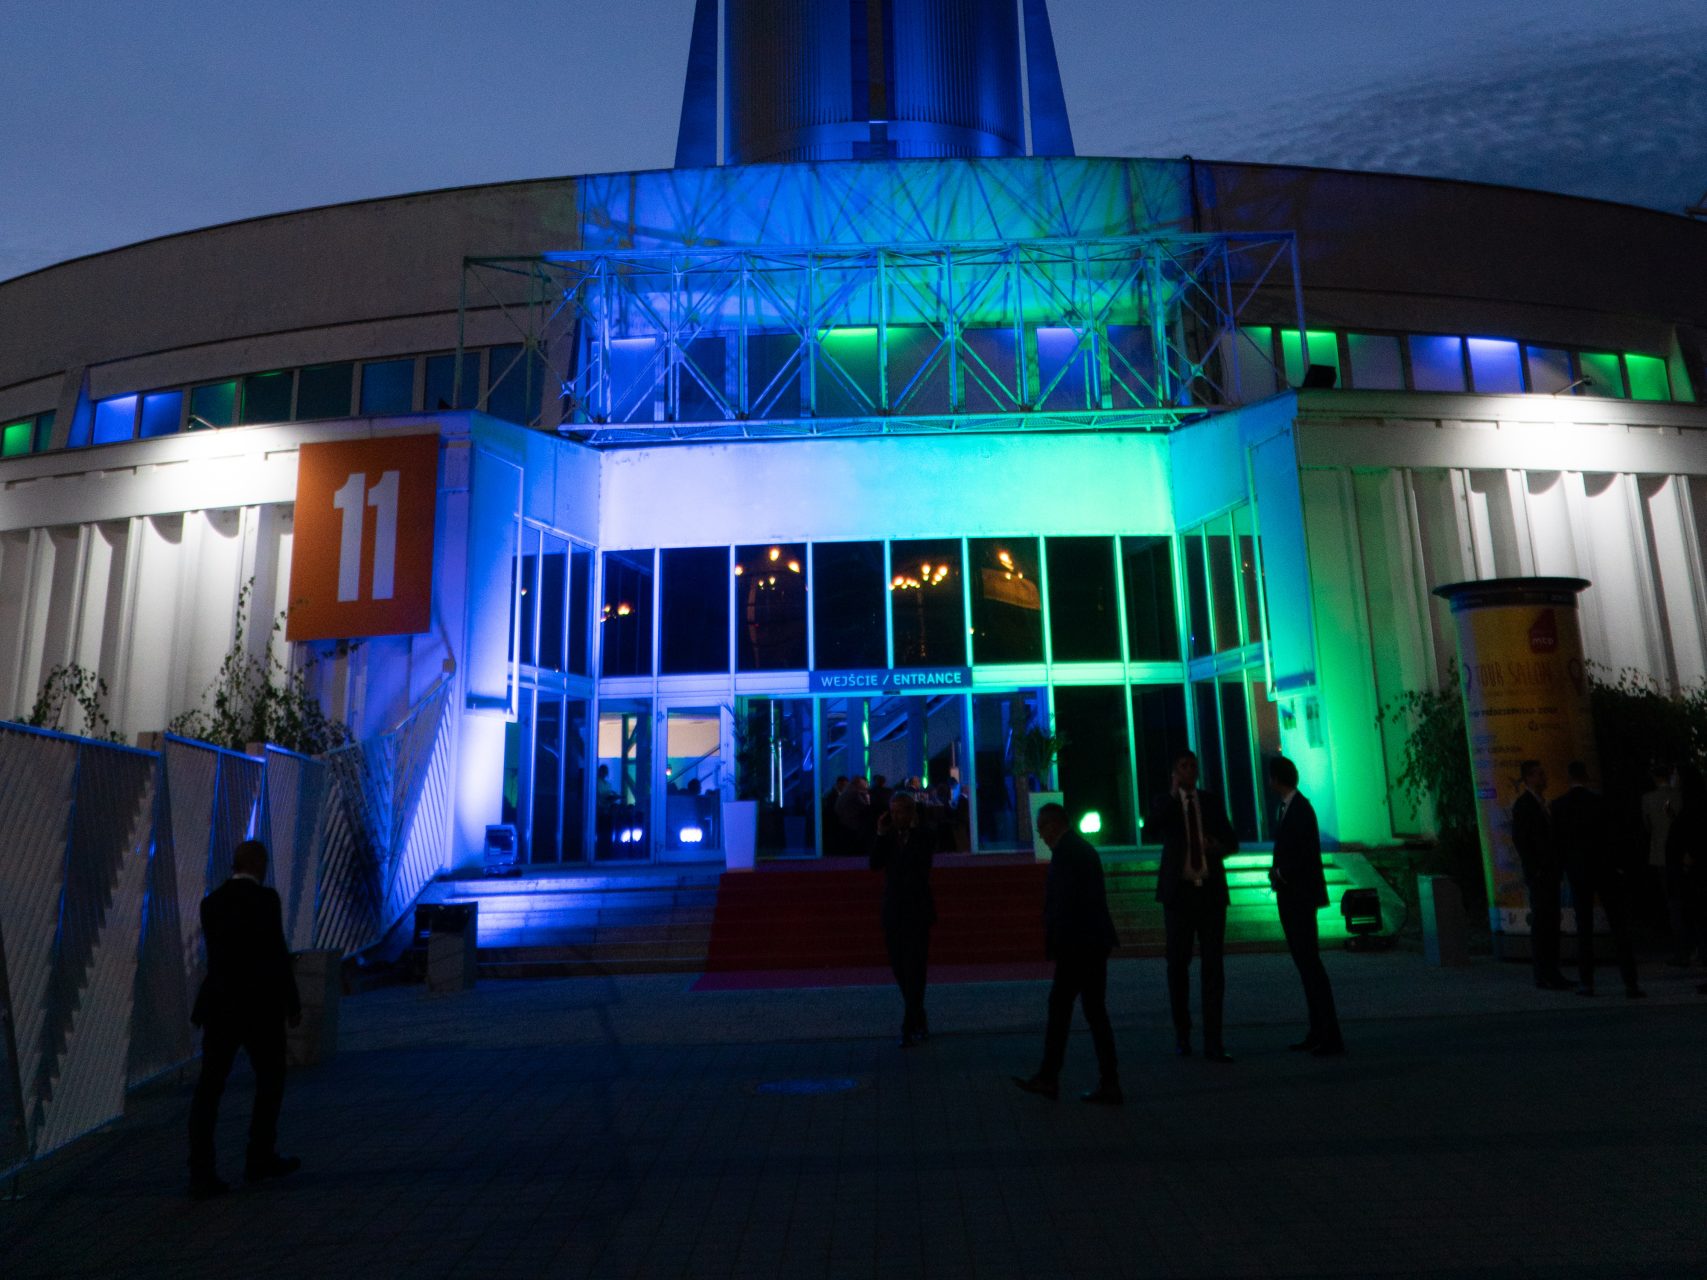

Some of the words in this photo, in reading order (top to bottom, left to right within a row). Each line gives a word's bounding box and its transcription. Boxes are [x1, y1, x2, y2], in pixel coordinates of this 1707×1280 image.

[333, 470, 400, 602] 11
[821, 674, 878, 687] WEJŚCIE
[893, 672, 961, 685] ENTRANCE
